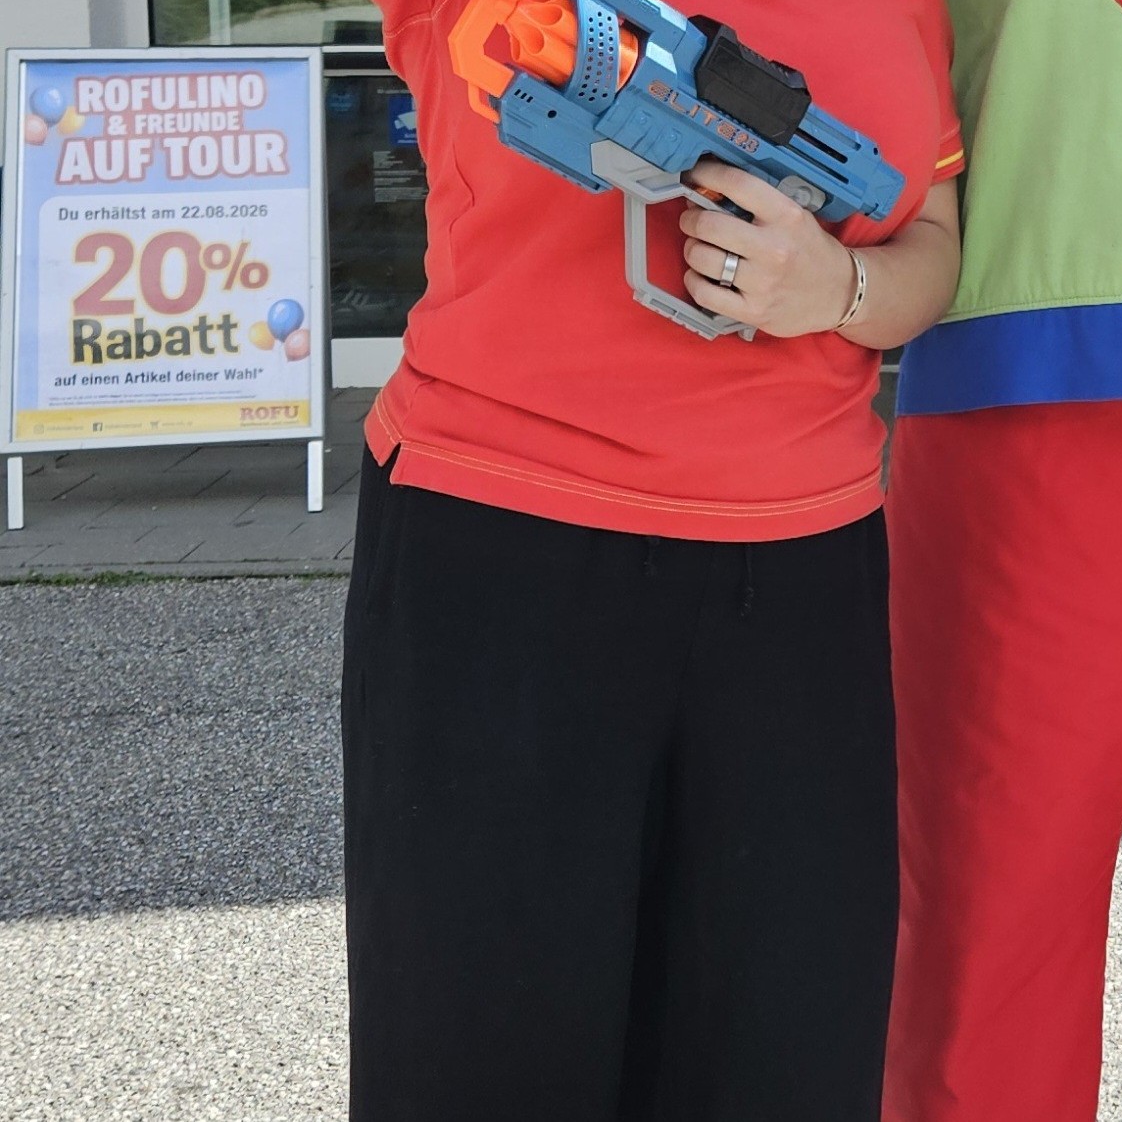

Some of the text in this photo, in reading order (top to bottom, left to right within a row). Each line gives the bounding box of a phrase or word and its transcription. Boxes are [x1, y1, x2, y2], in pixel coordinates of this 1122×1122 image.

[77, 73, 266, 114] ROFULINO
[107, 111, 240, 136] & FREUNDE
[58, 132, 288, 183] AUF TOUR
[58, 204, 268, 221] Du erhältst am 22.08.2026
[72, 230, 270, 316] 20%
[73, 313, 240, 365] Rabatt
[54, 373, 77, 388] auf
[81, 373, 120, 386] einen
[124, 371, 171, 385] Artikel
[175, 370, 220, 383] deiner
[240, 405, 300, 421] ROFU
